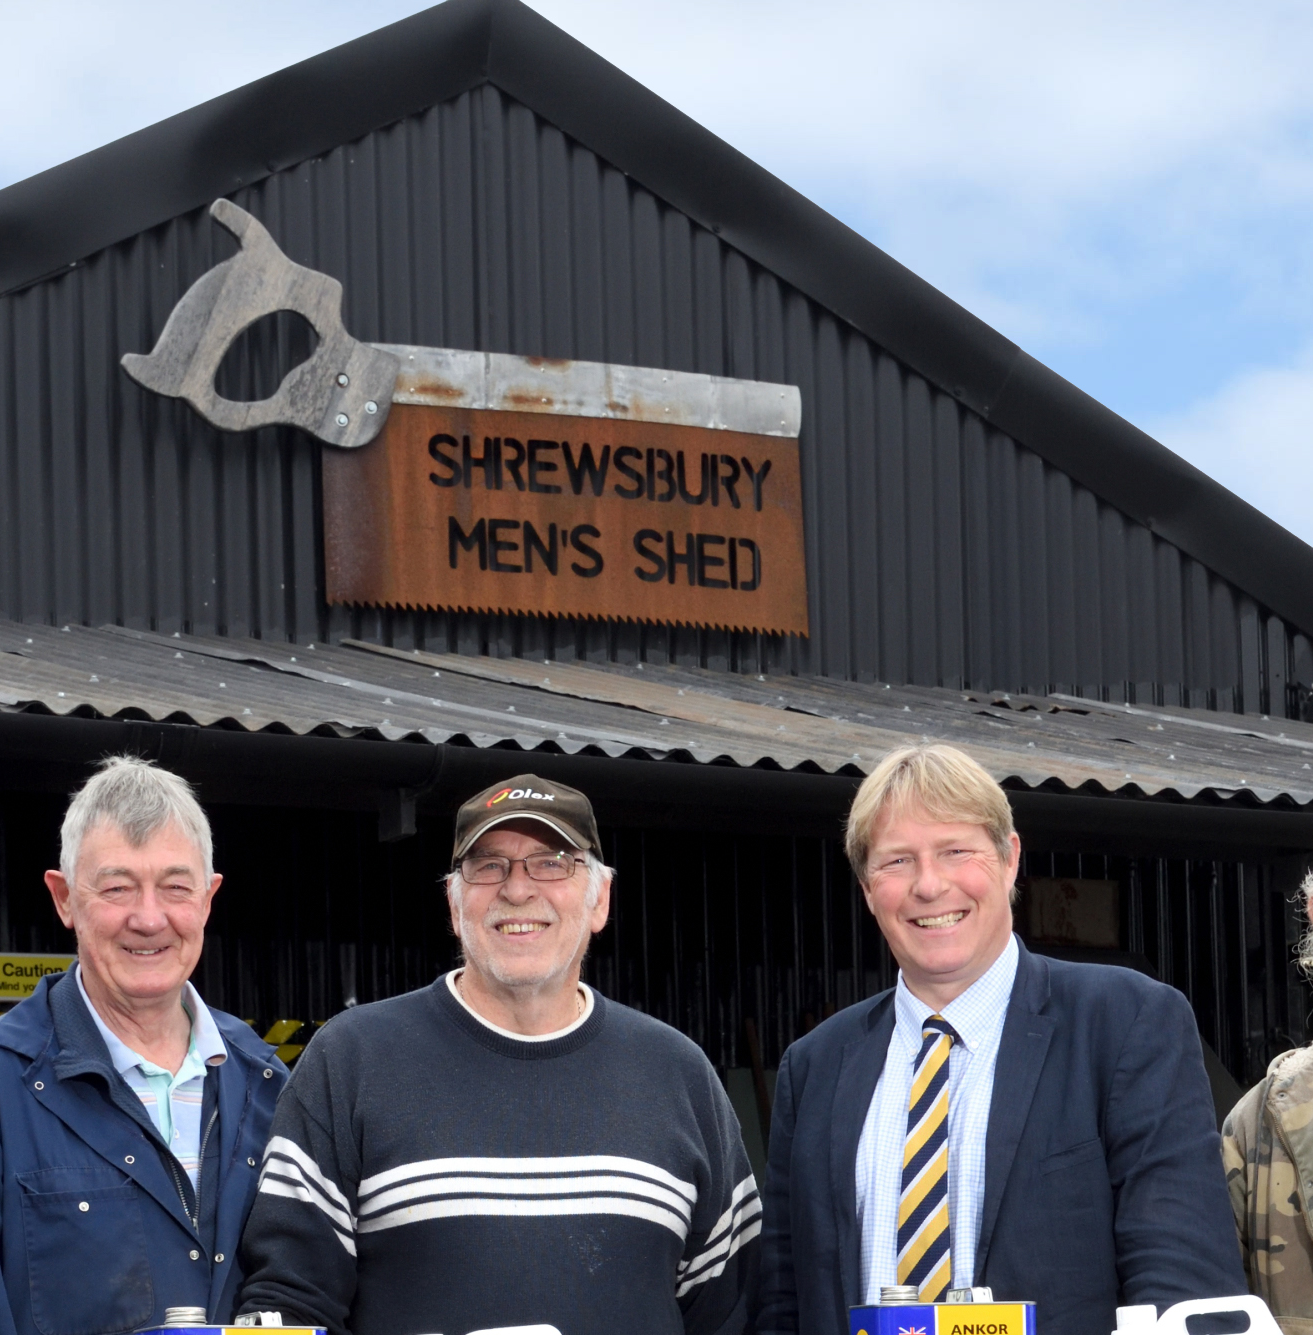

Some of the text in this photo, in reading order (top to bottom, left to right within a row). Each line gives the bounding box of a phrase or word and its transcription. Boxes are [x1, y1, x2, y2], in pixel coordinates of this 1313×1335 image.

[428, 433, 772, 511] SHREWSBURY
[448, 516, 762, 591] MEN'S SHED
[2, 962, 63, 977] Caution
[23, 983, 36, 993] yo
[951, 1324, 1008, 1335] ANKOR
